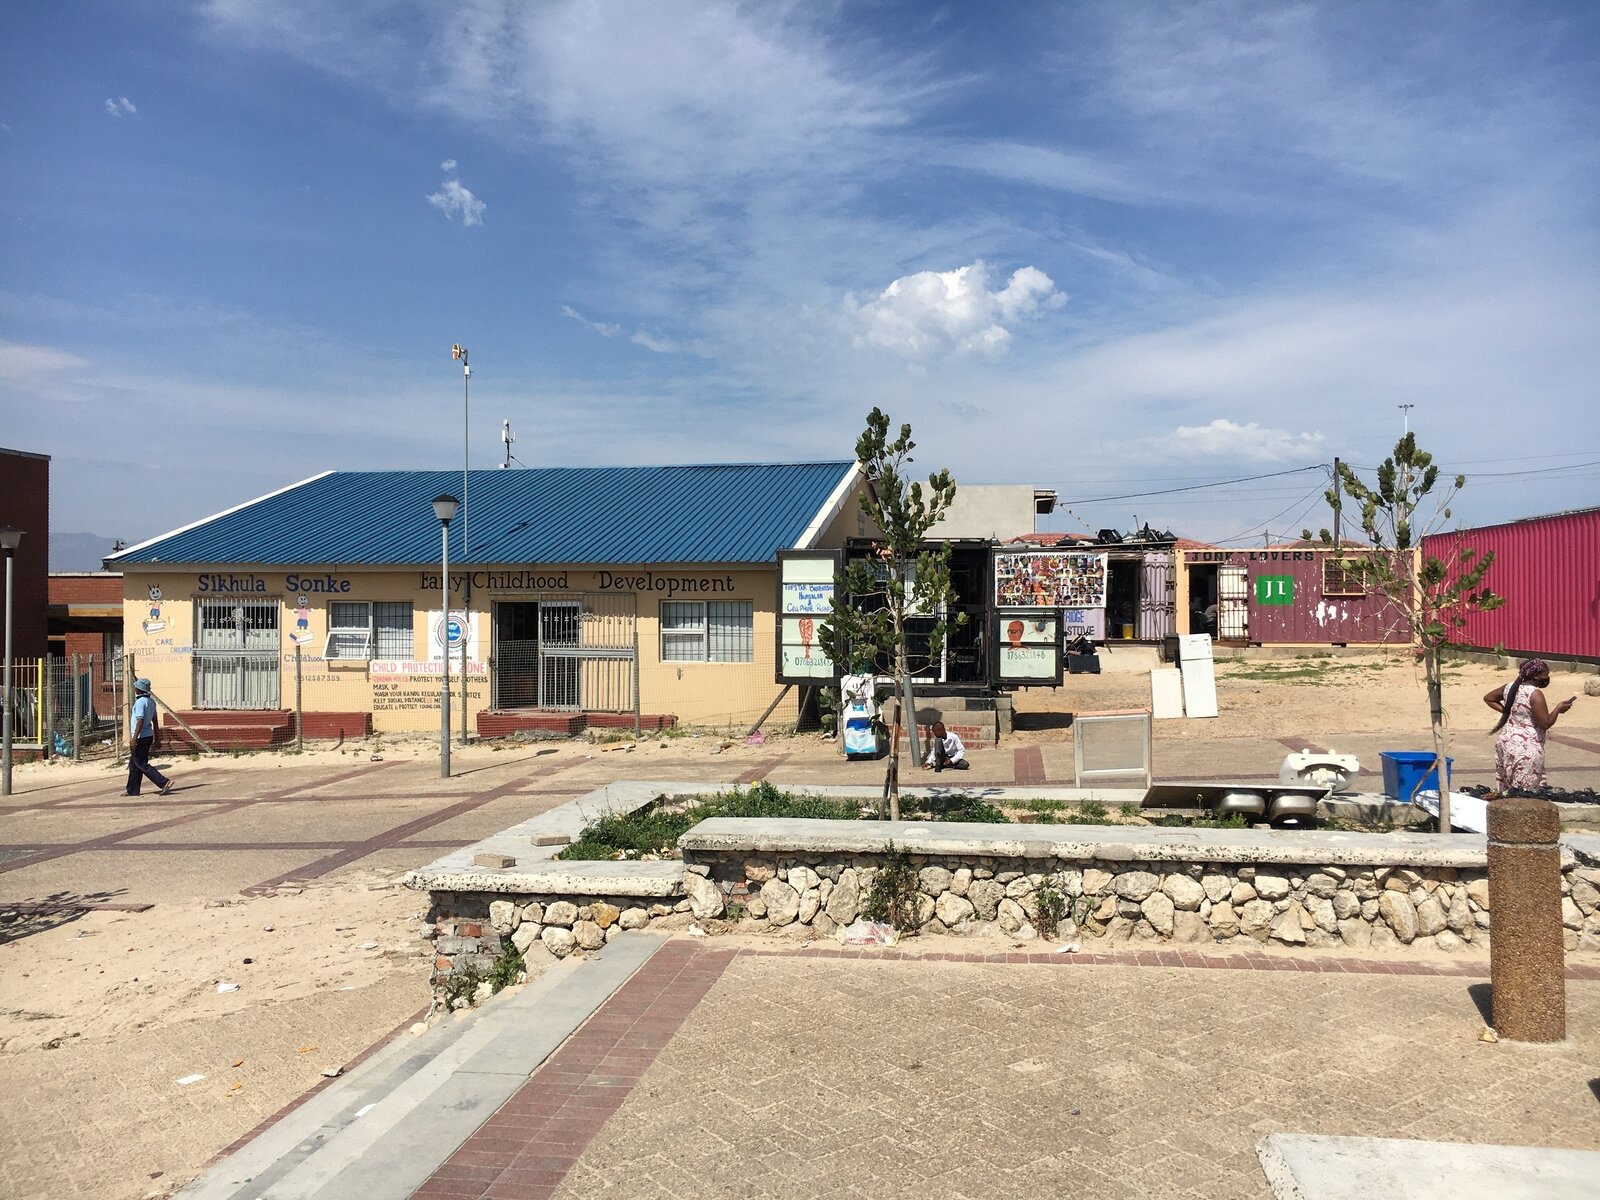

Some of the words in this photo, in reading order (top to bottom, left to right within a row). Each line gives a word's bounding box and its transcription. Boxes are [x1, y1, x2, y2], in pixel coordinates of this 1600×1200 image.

[1192, 551, 1234, 562] JUNK
[1249, 551, 1314, 561] LOVERS
[198, 574, 266, 592] Sikhula
[285, 573, 351, 593] Sonke
[420, 571, 463, 592] Eary
[472, 571, 569, 589] Childhood
[599, 571, 735, 597] Development
[1066, 626, 1095, 636] STOVE
[155, 638, 174, 646] CARE
[129, 647, 155, 656] PROTECT
[372, 662, 397, 673] CHILD
[410, 675, 433, 683] PROTECT
[466, 676, 488, 684] OTHERS
